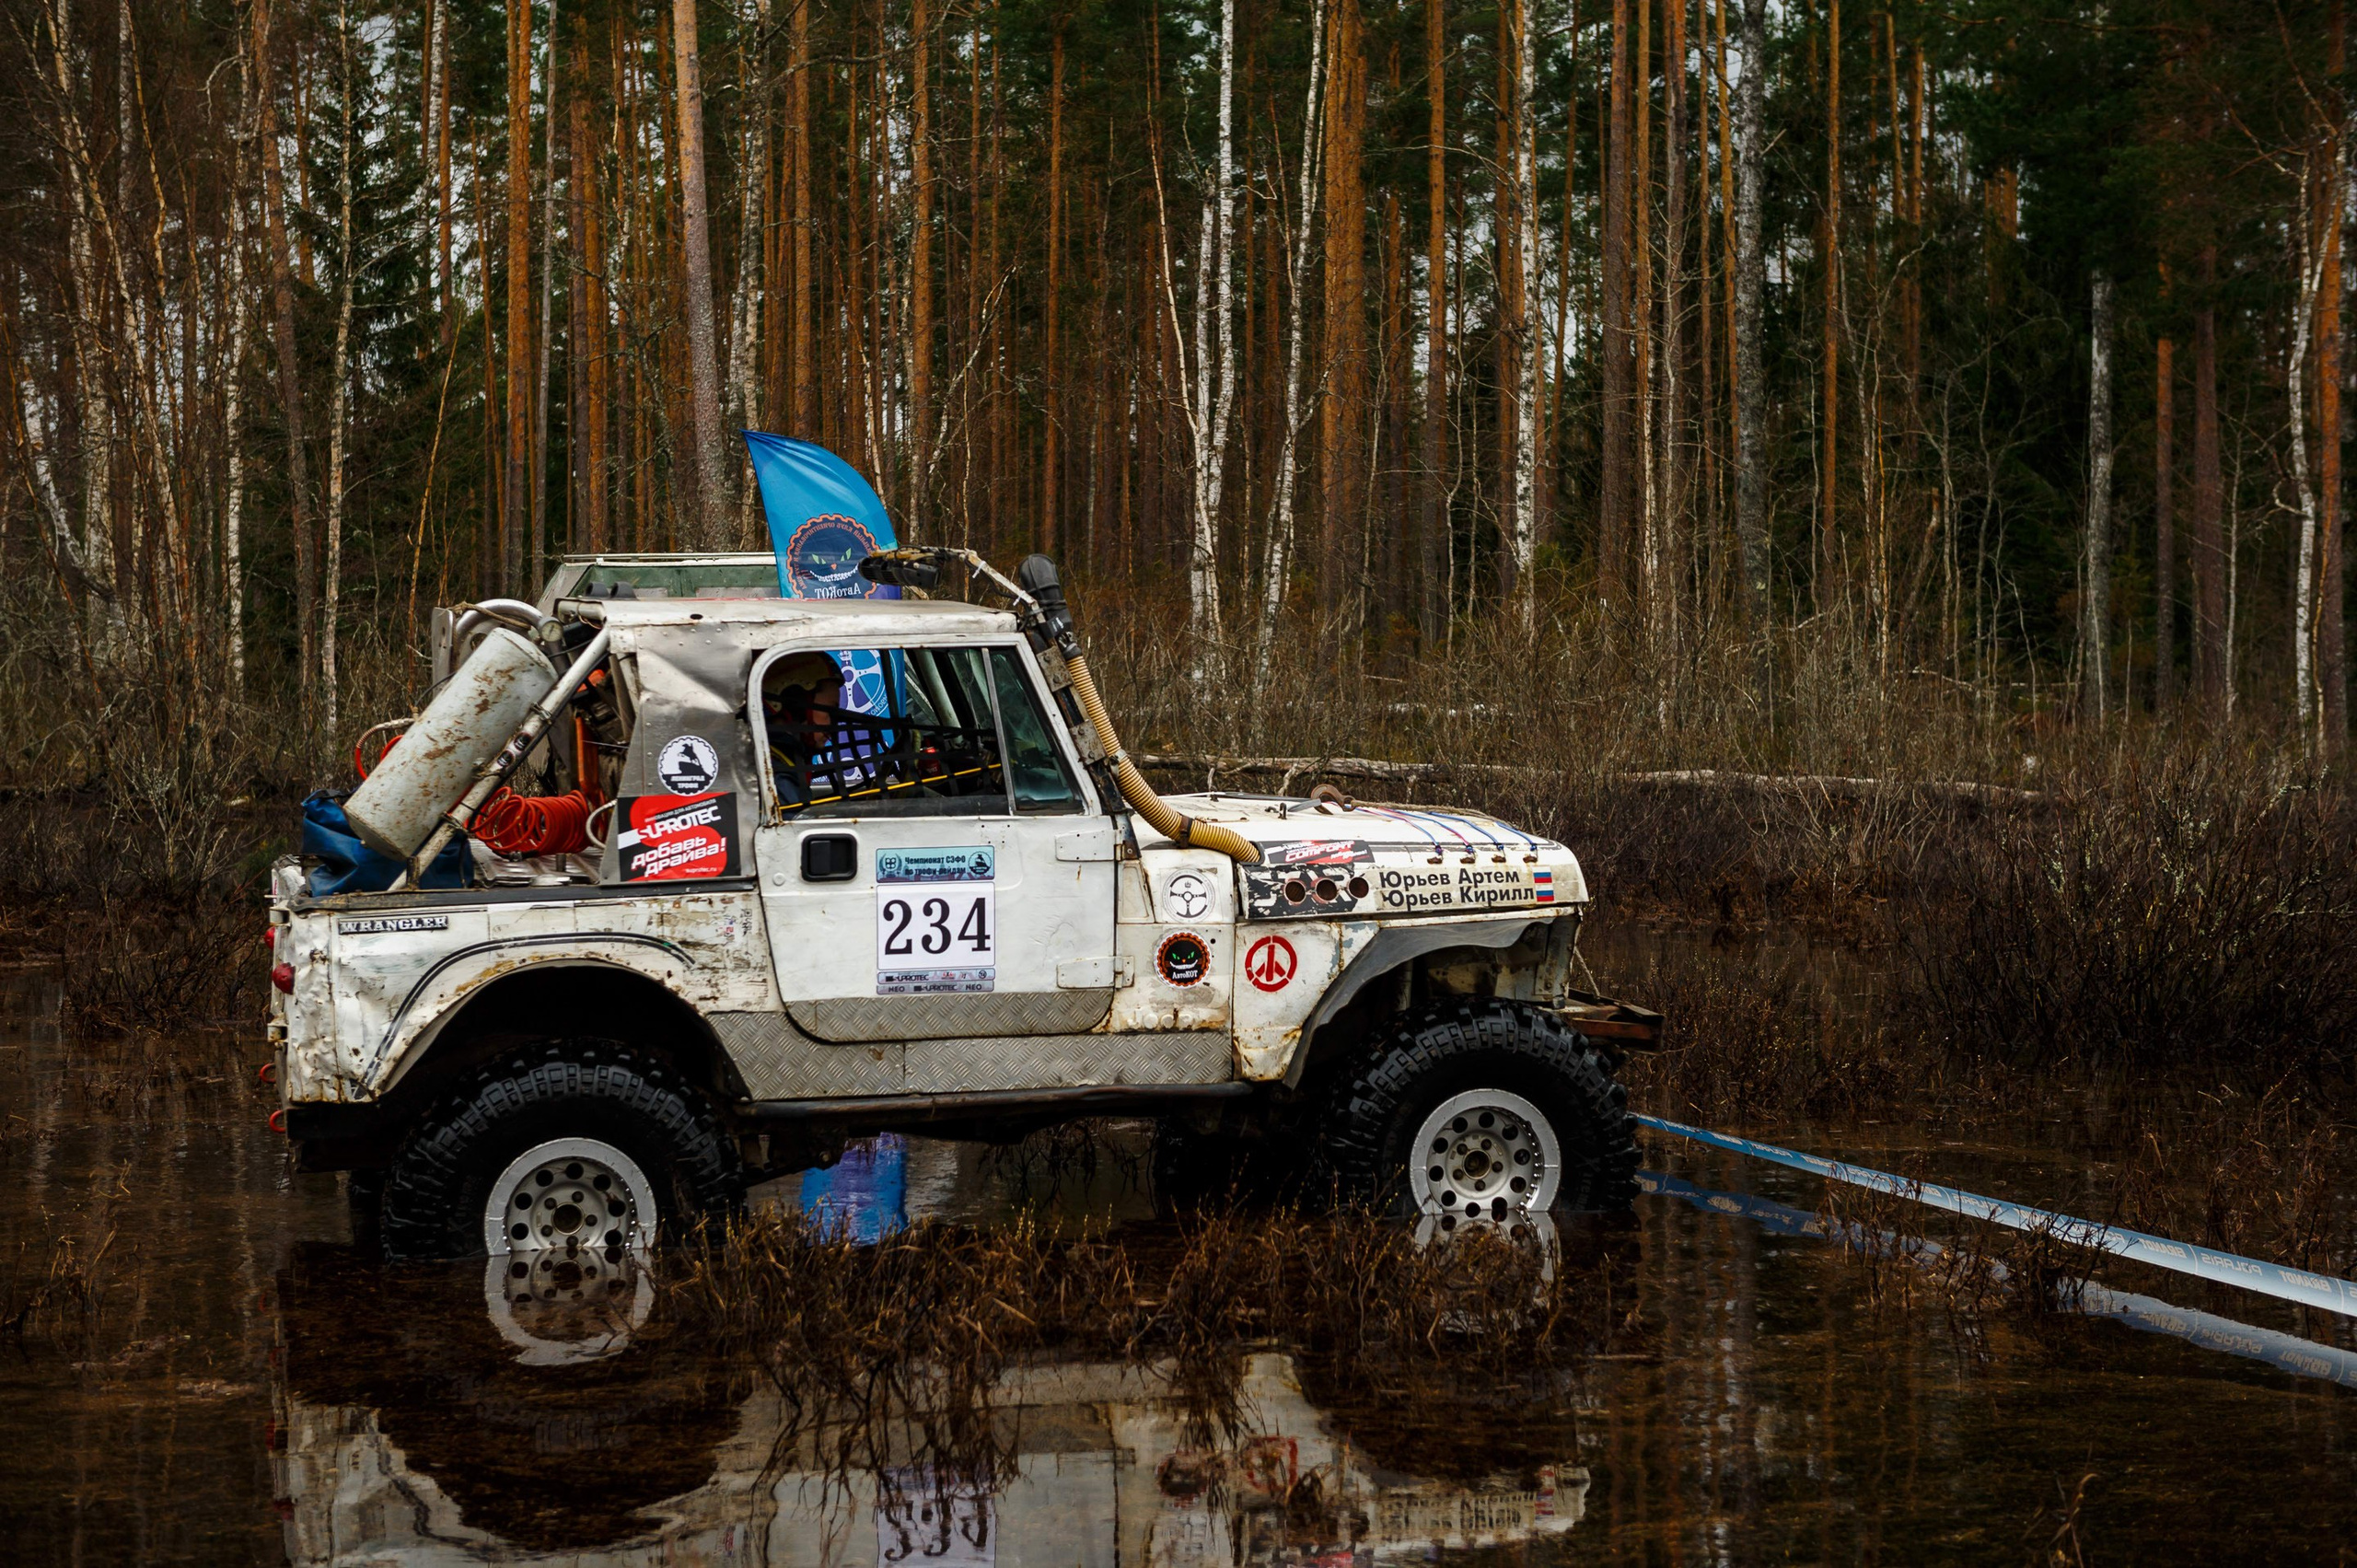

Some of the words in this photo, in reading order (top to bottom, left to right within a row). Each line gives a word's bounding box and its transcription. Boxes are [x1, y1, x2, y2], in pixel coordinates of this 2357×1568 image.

[638, 806, 722, 841] SUPROTEC
[904, 856, 945, 865] Чемпионат
[946, 855, 966, 864] СЗФО
[1380, 870, 1451, 890] Юрьев
[1457, 868, 1520, 889] Артем
[1382, 889, 1453, 912] Юрьев
[1459, 886, 1535, 907] Кирилл
[340, 916, 447, 934] WRANGLER
[882, 897, 991, 956] 234
